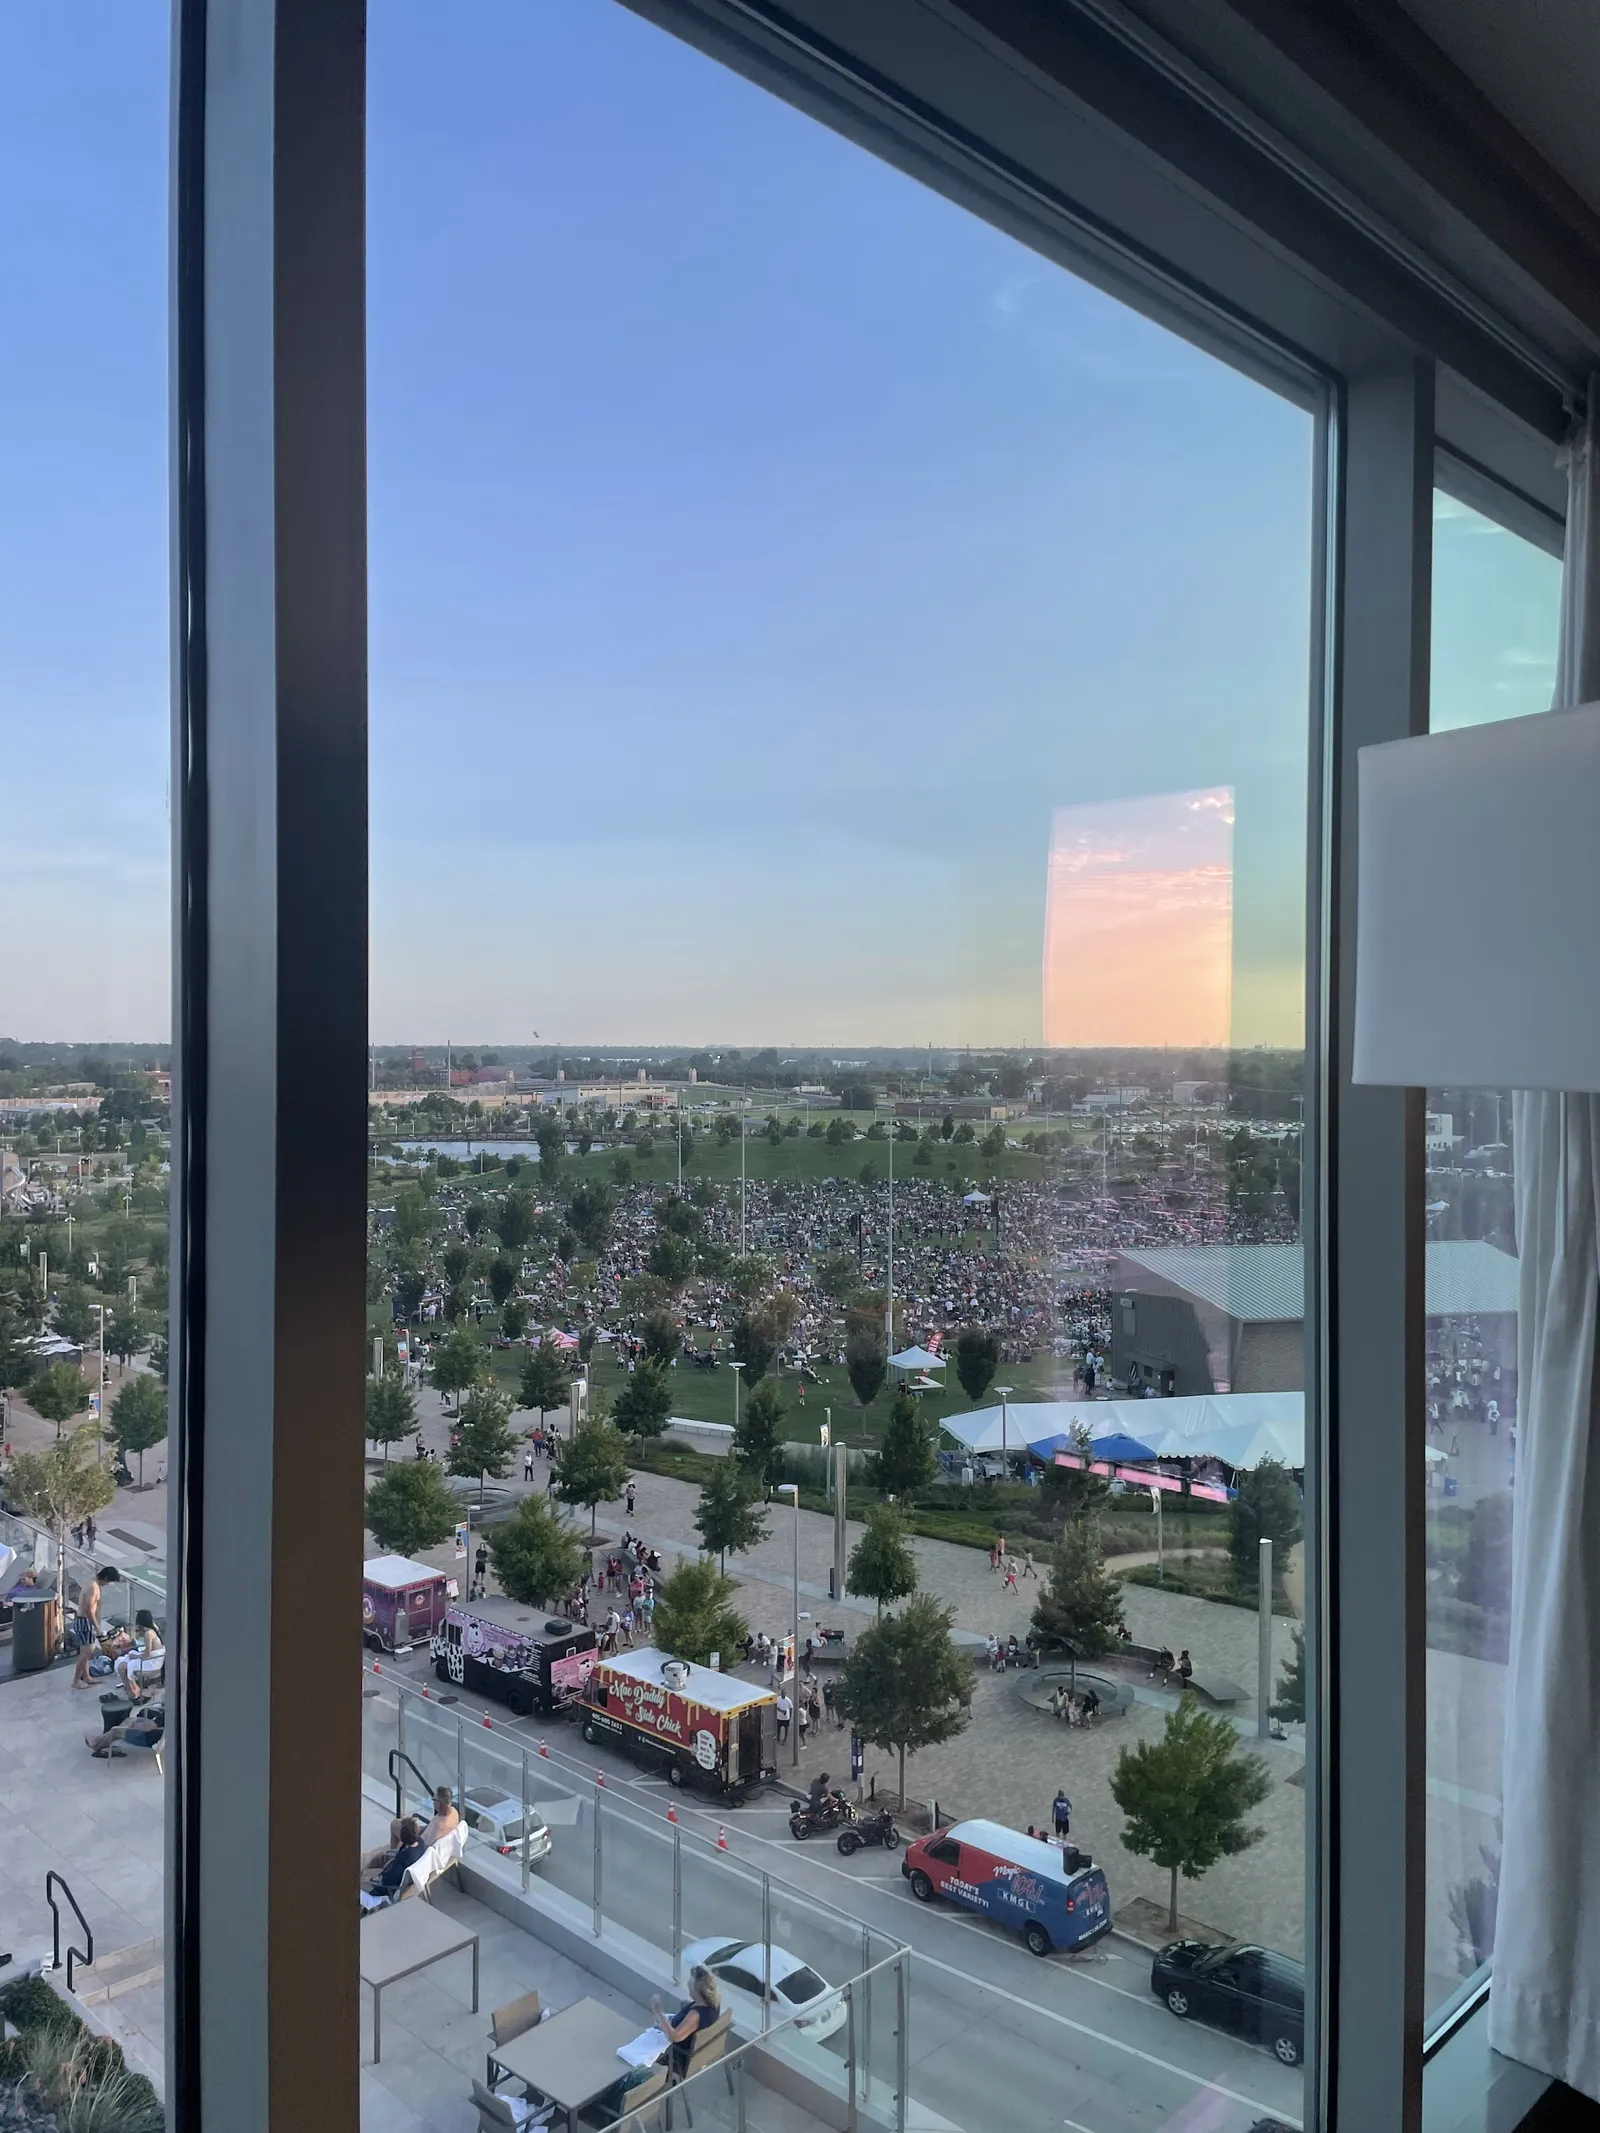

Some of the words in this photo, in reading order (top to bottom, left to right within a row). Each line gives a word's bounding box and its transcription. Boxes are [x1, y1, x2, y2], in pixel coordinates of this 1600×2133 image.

[609, 1680, 632, 1702] Mac
[634, 1685, 665, 1709] Daddy
[635, 1706, 656, 1723] Side
[656, 1714, 682, 1739] Chick
[993, 1865, 1021, 1881] Magic
[940, 1880, 957, 1893] BEST
[949, 1876, 979, 1896] TODAY'S
[1002, 1891, 1031, 1910] KMGL
